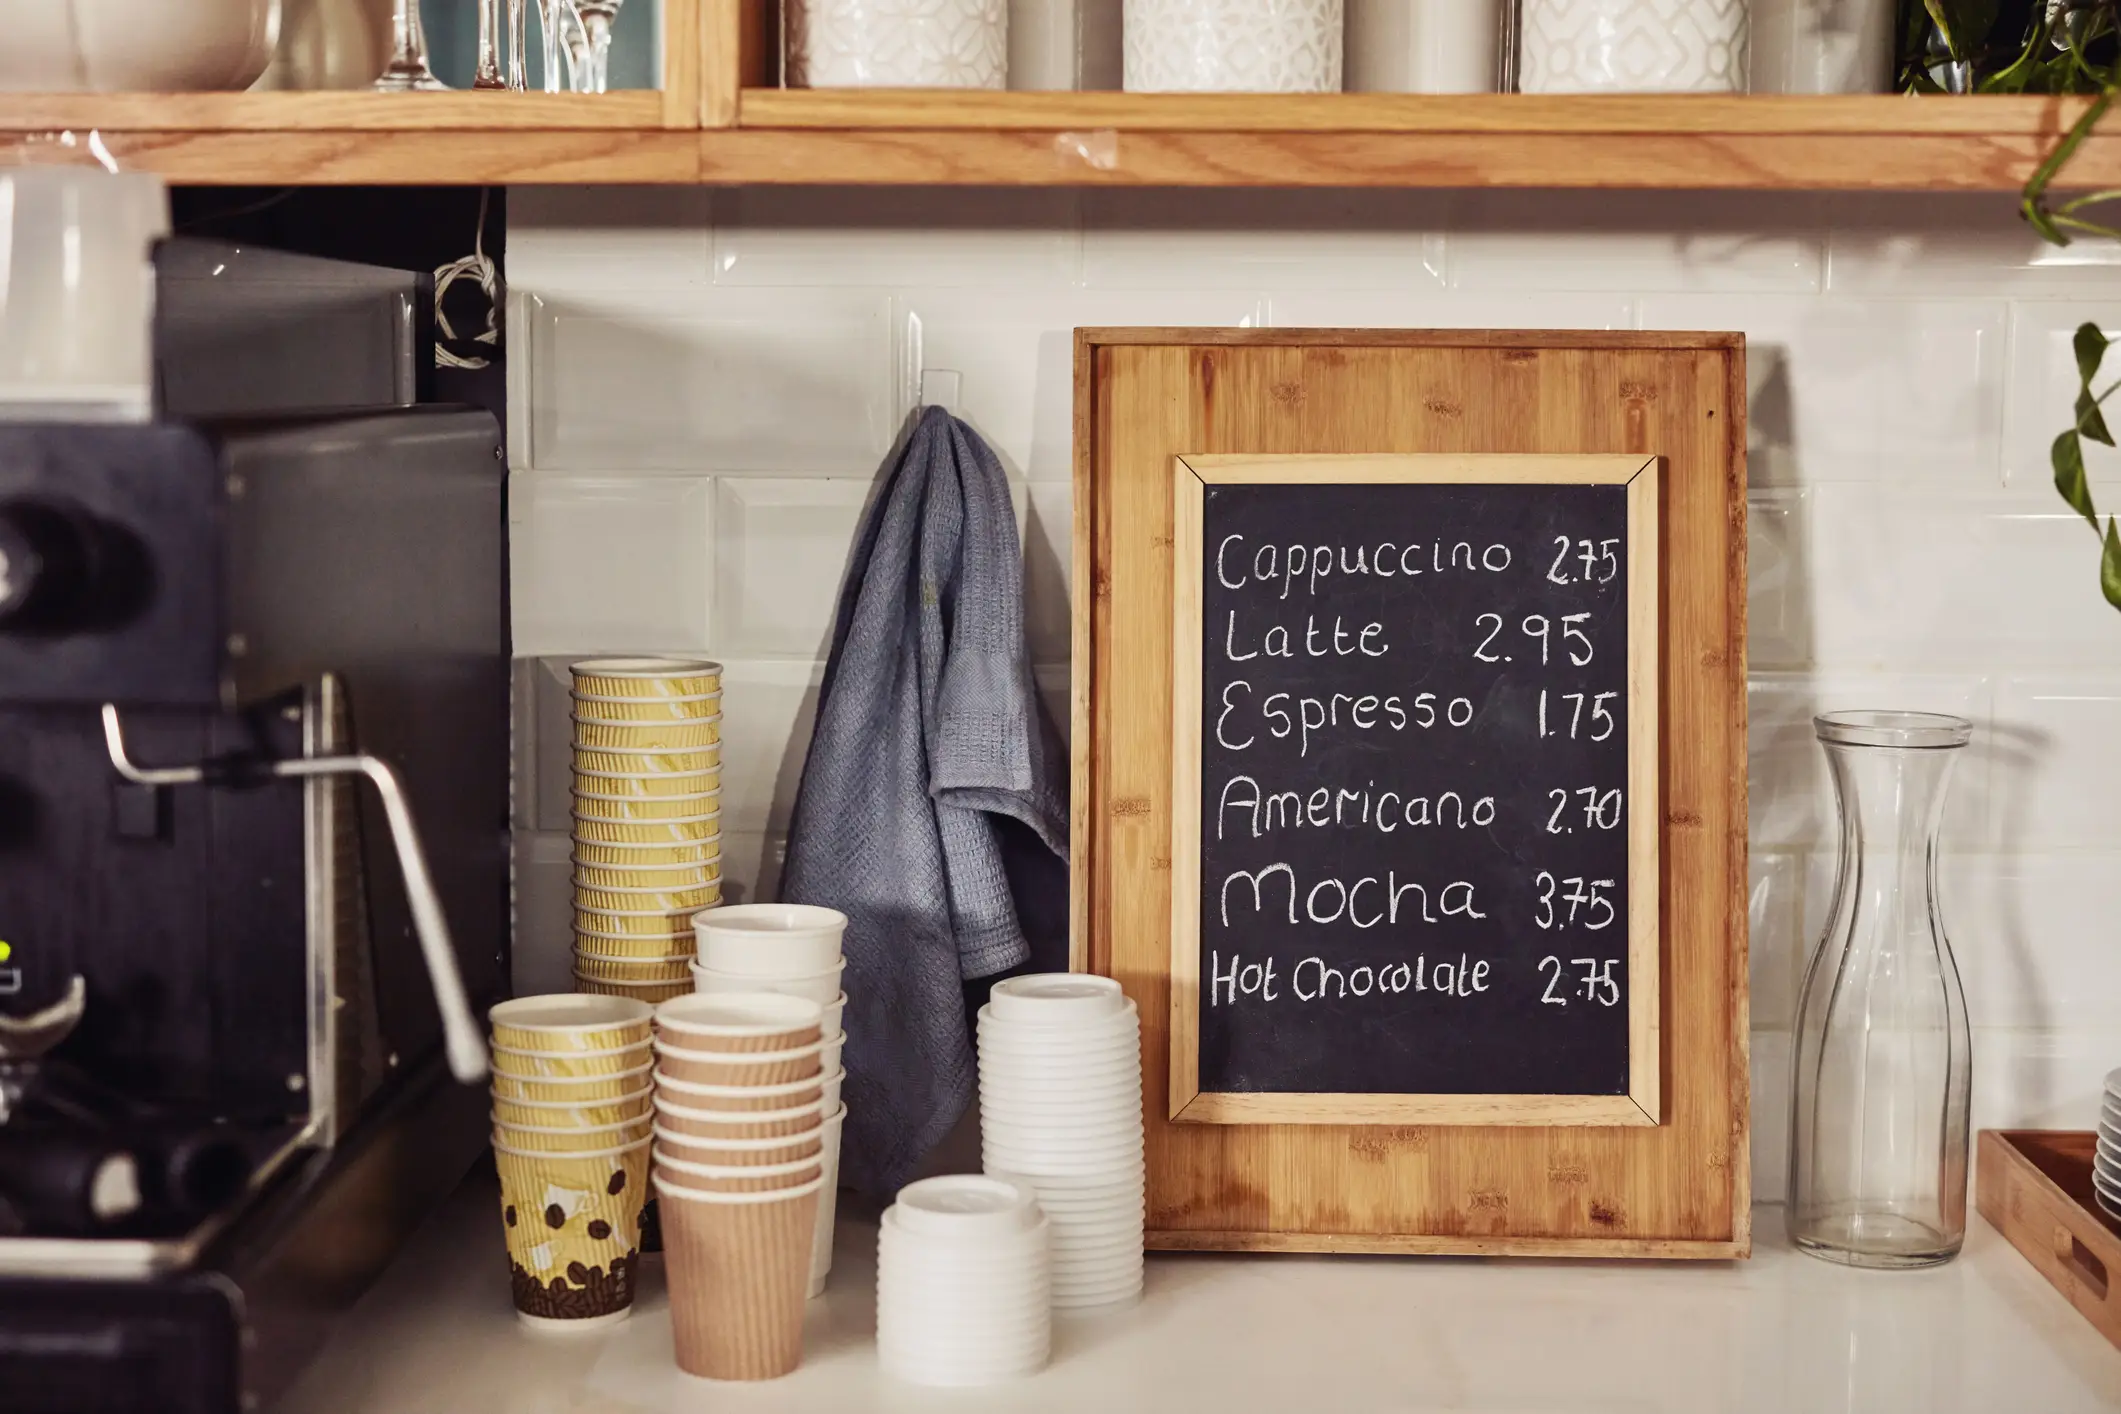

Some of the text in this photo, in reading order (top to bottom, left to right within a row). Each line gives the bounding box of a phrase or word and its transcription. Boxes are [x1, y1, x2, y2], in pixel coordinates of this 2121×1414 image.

[1217, 534, 1620, 600] Cappuccino 2.75
[1226, 609, 1594, 667] Latte 2.95
[1216, 680, 1618, 758] Espresso 1.75
[1218, 774, 1622, 840] Americano 2.70
[1220, 862, 1616, 931] Mocha 3.75
[1211, 949, 1620, 1007] Hot Chocolate 2.75
